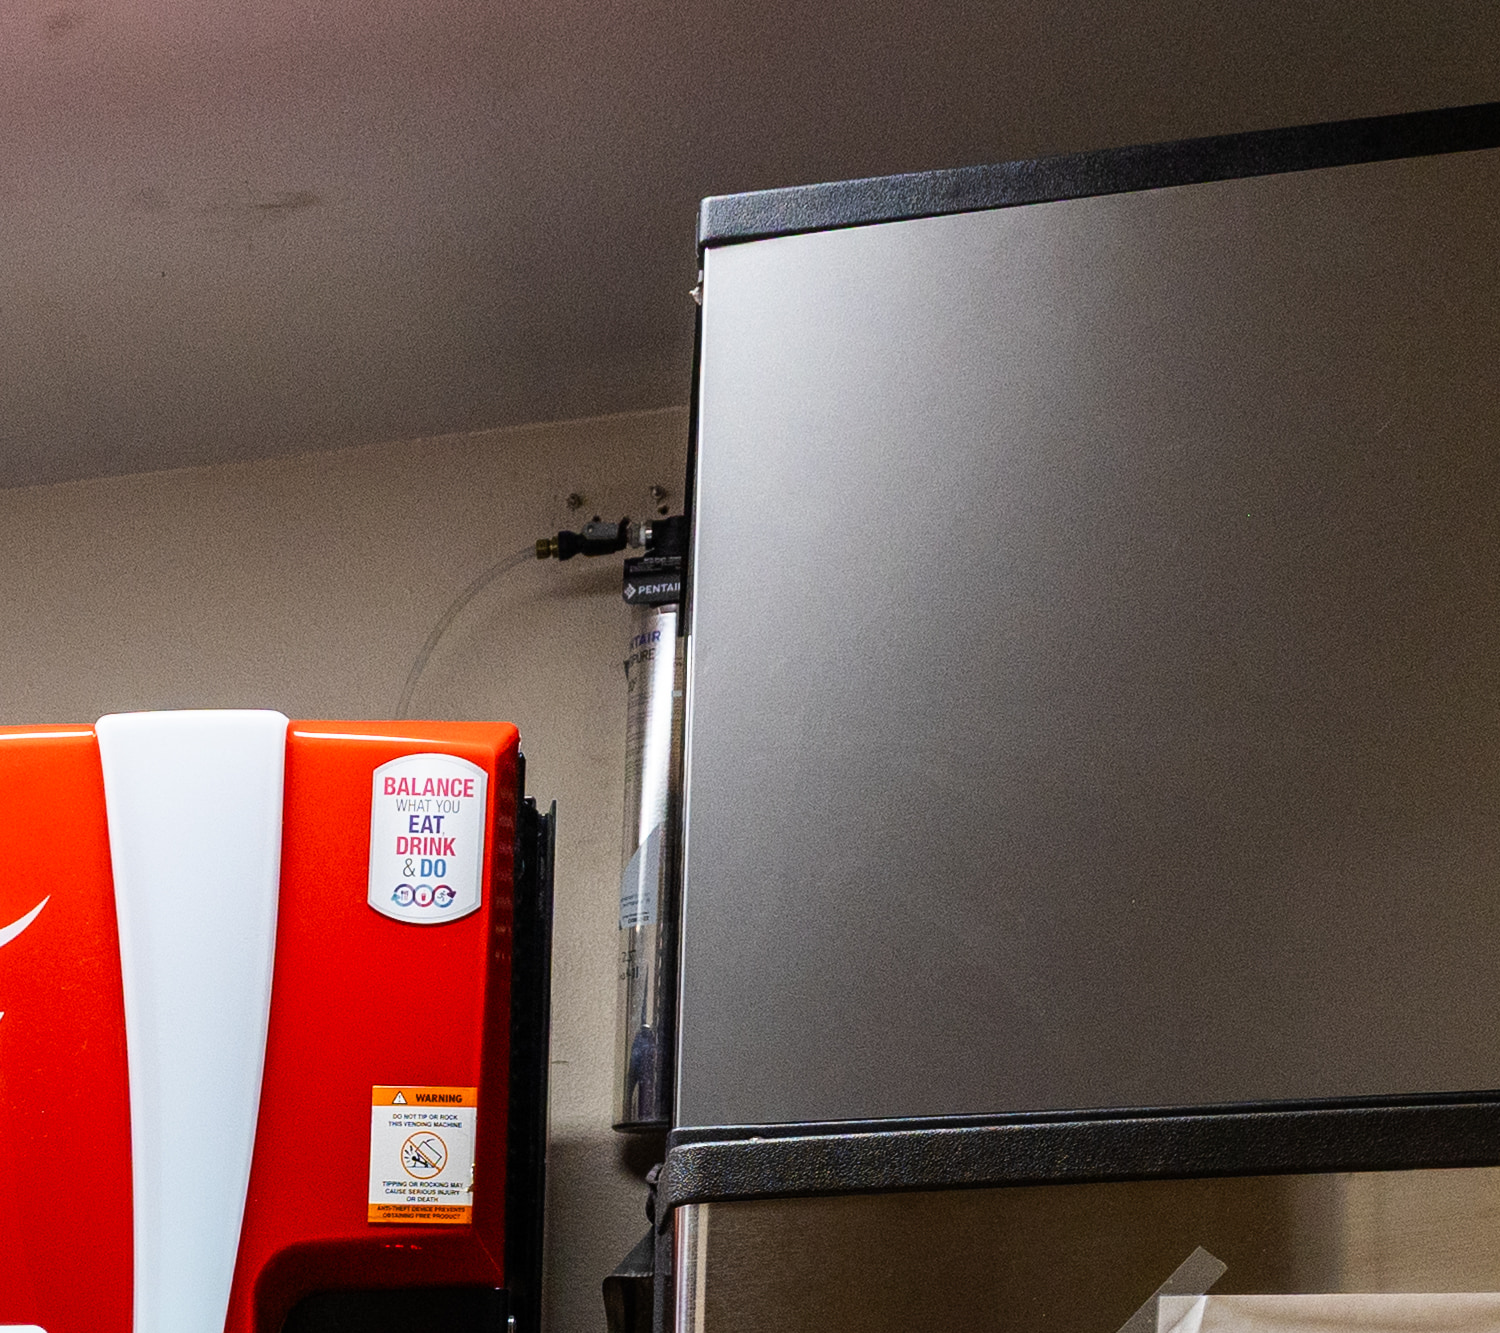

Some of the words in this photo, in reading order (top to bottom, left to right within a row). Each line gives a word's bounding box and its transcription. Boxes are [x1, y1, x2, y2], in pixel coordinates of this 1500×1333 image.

[384, 777, 474, 798] BALANCE
[396, 799, 432, 812] WHAT
[436, 800, 460, 813] YOU
[396, 836, 456, 857] DRINK
[402, 858, 416, 878] &
[420, 859, 447, 878] DO
[416, 1093, 463, 1103] WARNING
